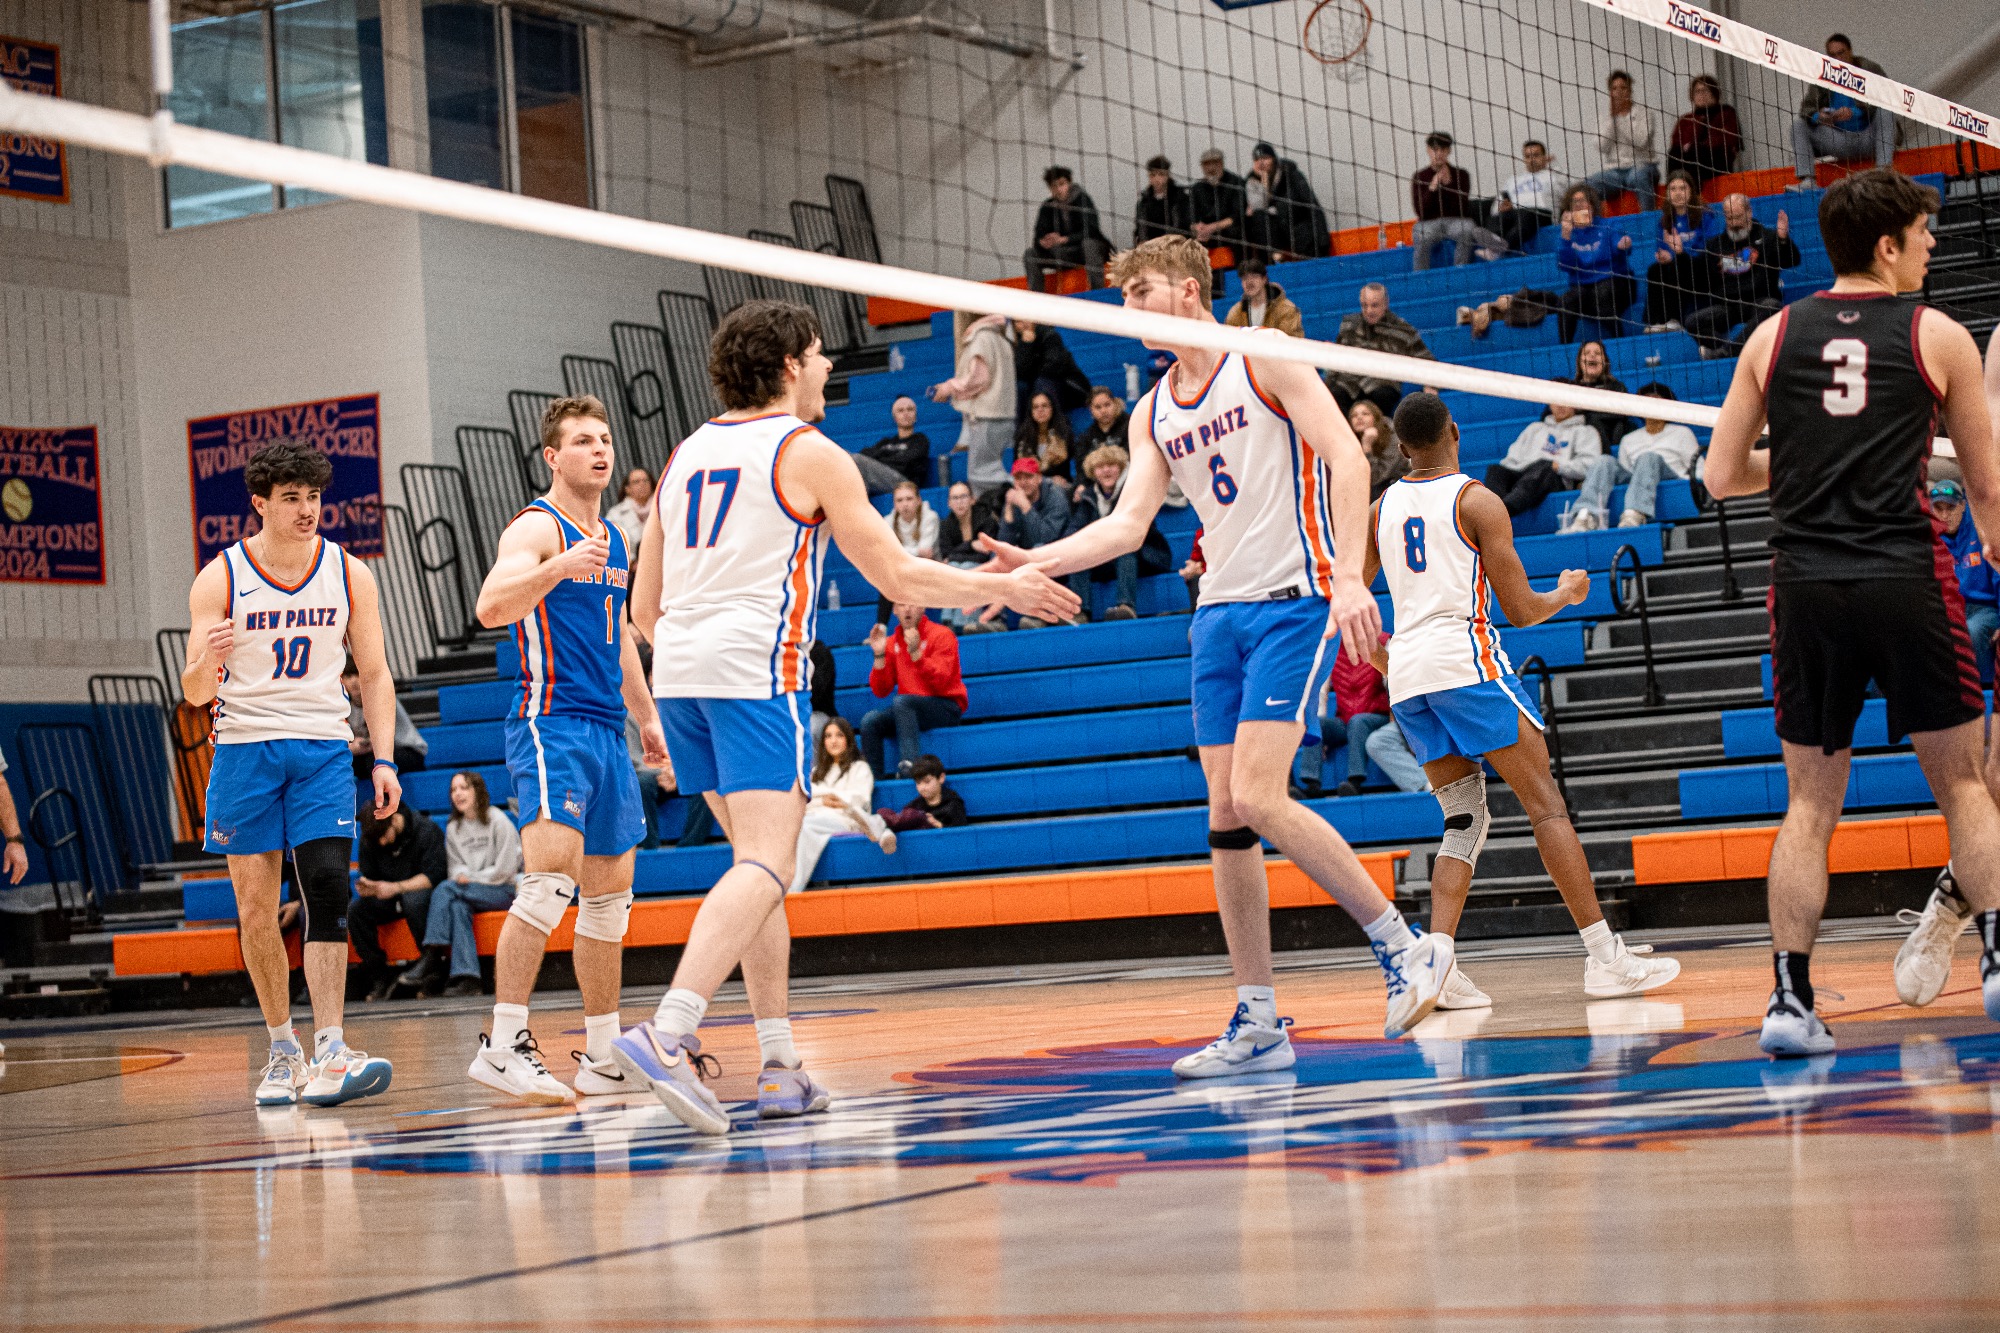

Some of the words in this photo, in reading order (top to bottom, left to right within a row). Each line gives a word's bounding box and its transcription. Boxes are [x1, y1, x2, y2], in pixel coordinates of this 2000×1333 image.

[1822, 338, 1868, 416] 3
[227, 402, 340, 443] SUNYAC
[1208, 452, 1238, 506] 6
[199, 492, 381, 545] CHAONS
[685, 467, 741, 549] 17
[1403, 516, 1427, 573] 8
[246, 610, 281, 630] NEW
[286, 608, 337, 629] PALTZ
[605, 594, 613, 645] 1
[271, 635, 312, 680] 10
